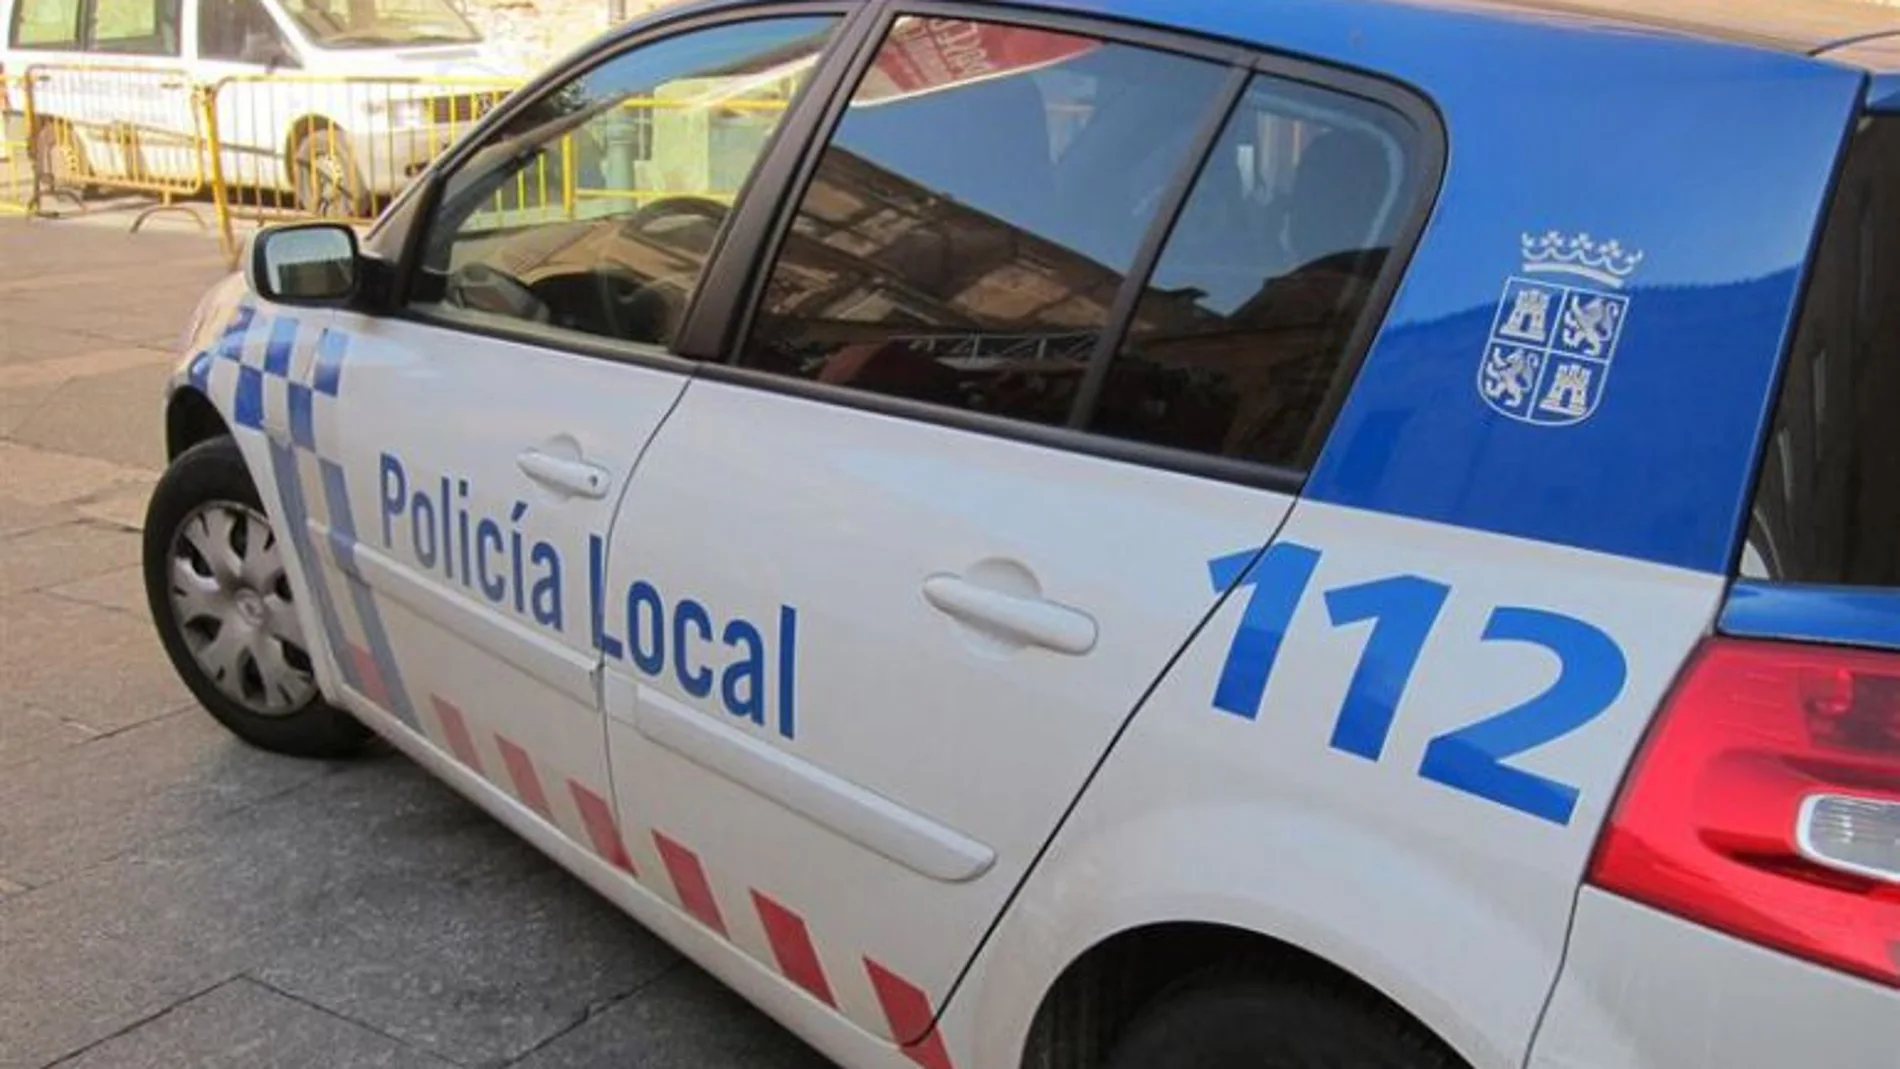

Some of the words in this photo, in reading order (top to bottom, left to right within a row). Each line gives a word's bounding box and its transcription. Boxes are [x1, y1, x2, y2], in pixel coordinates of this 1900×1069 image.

[379, 452, 563, 632] Policía
[588, 534, 797, 740] Local
[1207, 541, 1627, 826] 112
